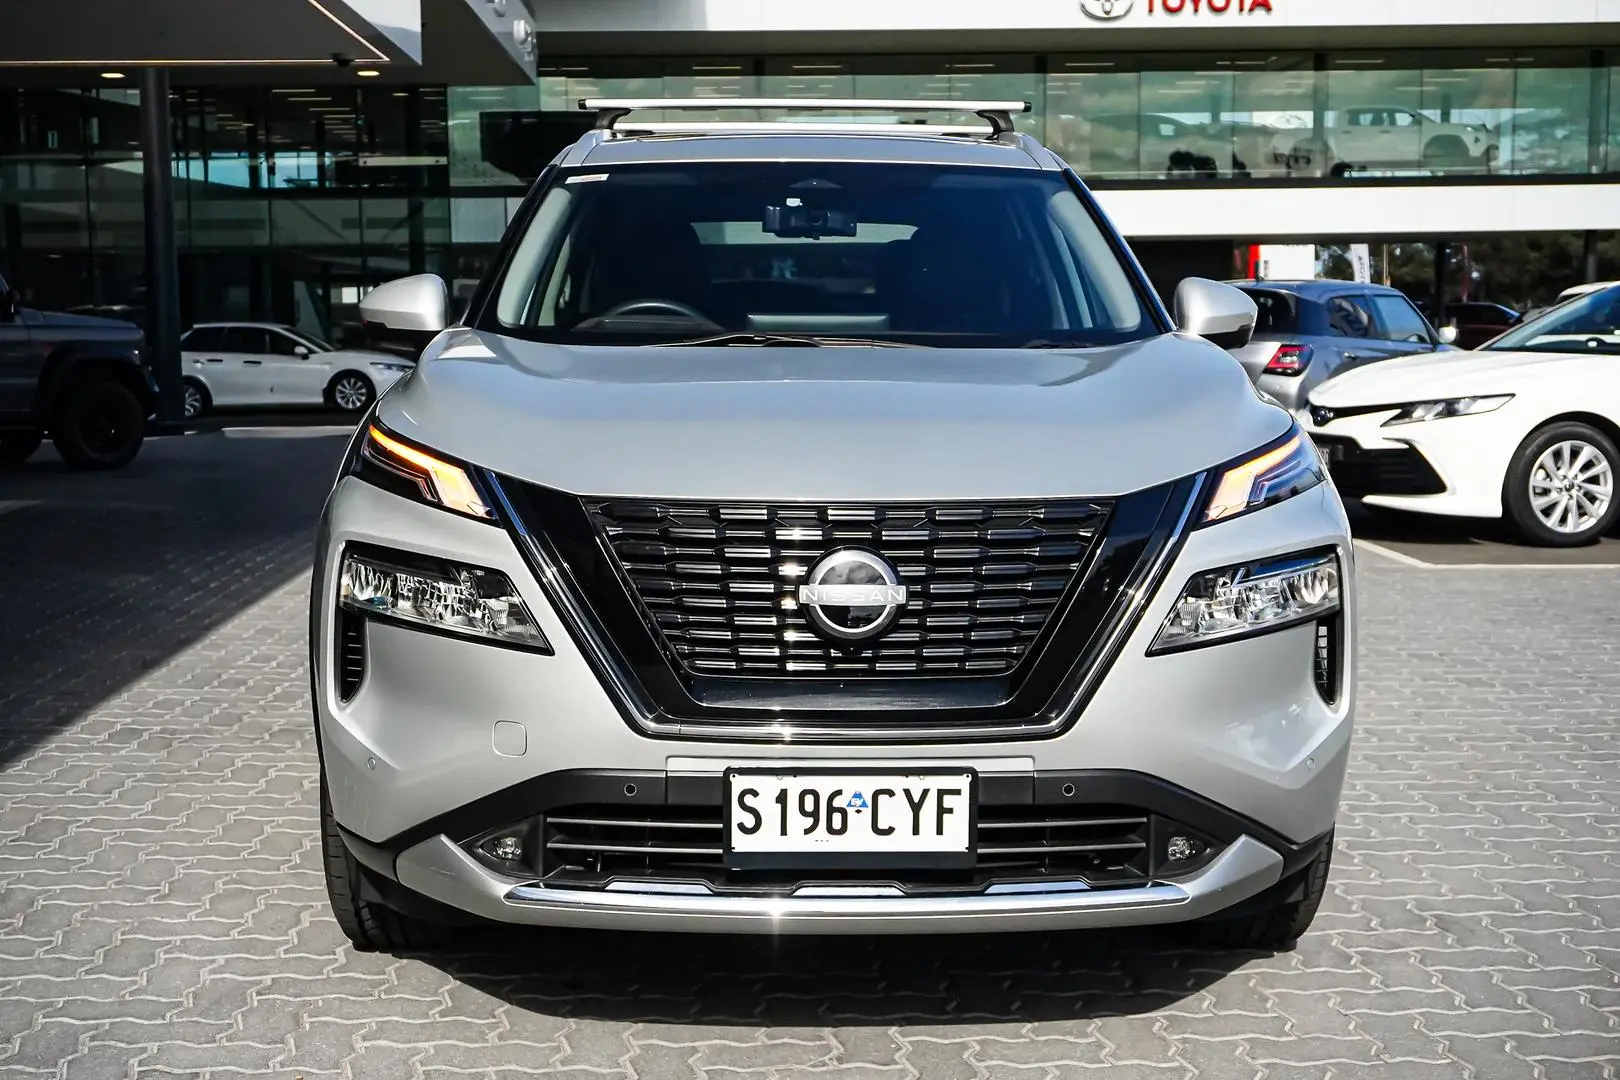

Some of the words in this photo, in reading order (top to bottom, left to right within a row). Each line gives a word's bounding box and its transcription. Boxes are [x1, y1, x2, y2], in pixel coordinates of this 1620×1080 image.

[802, 587, 903, 602] NISSAN
[736, 788, 848, 837] S196
[871, 788, 962, 836] CYF
